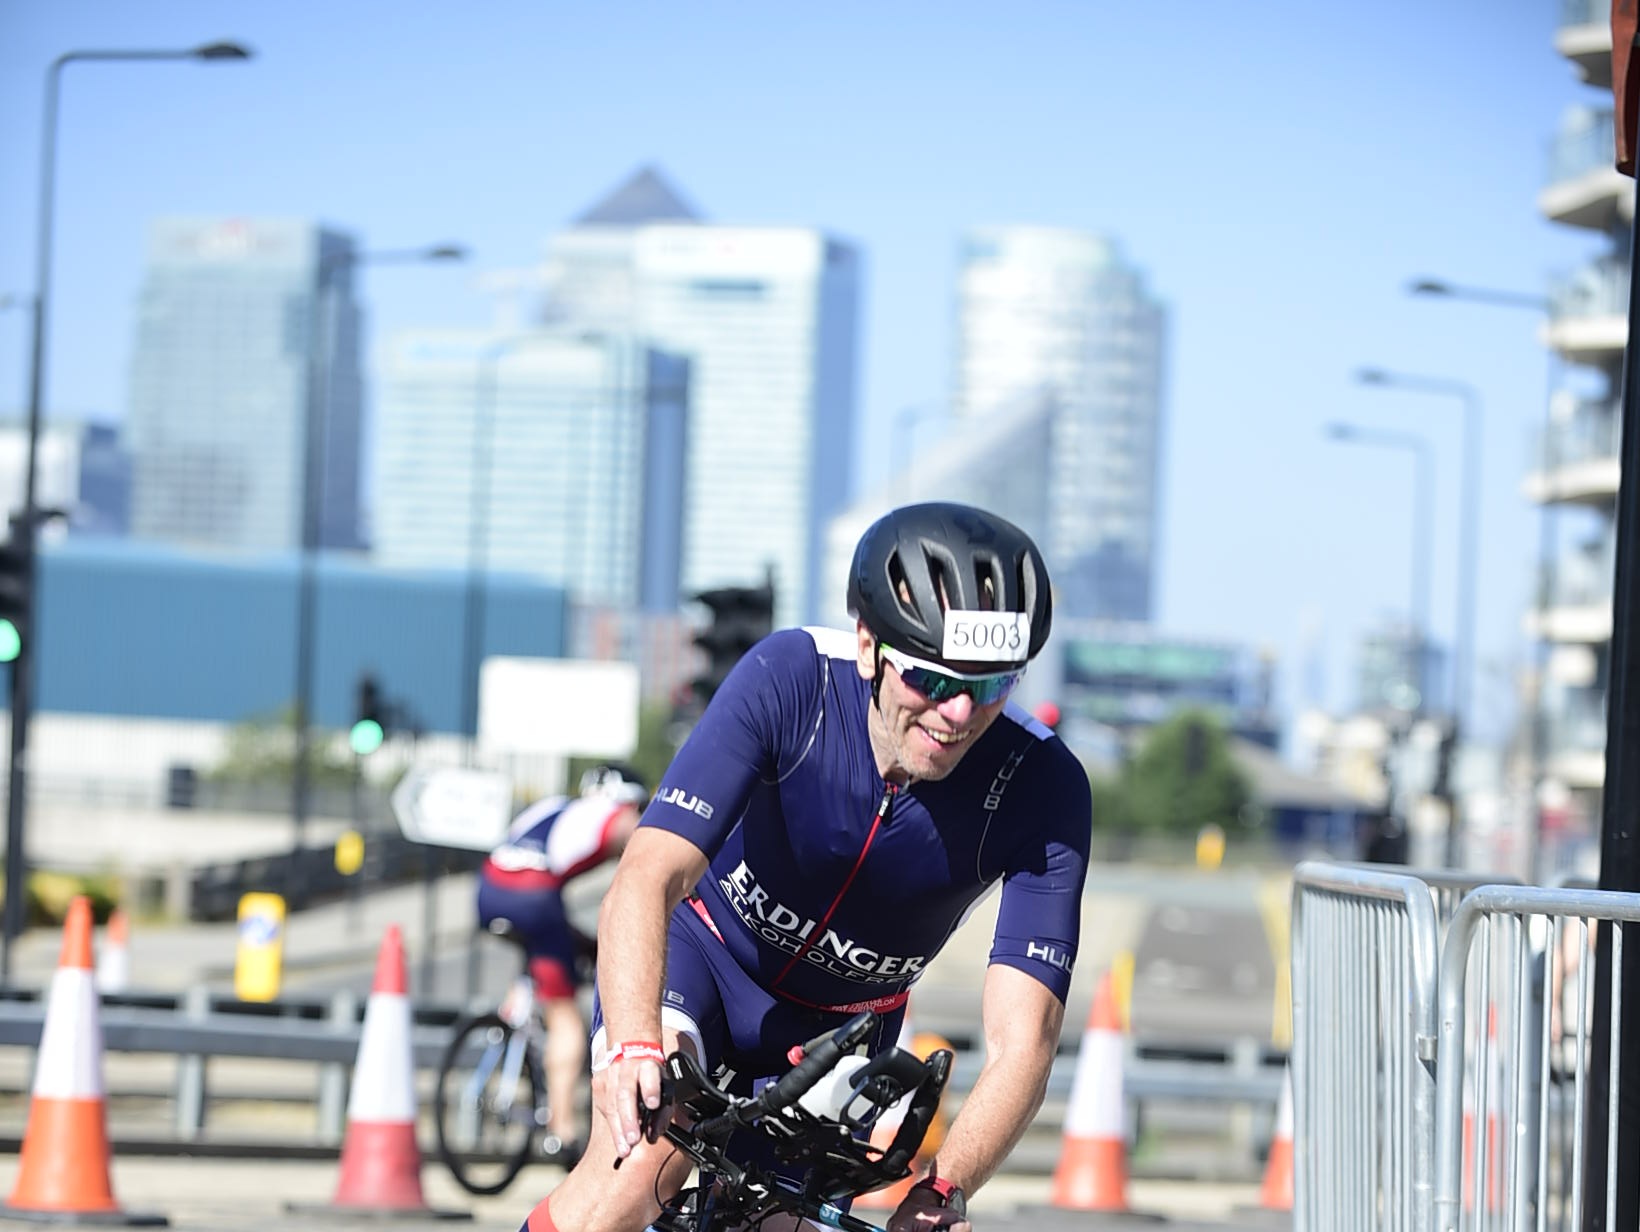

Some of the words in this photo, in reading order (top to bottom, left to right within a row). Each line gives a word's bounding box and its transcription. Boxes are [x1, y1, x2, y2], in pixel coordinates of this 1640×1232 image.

[953, 622, 1021, 650] 5003
[983, 751, 1023, 810] HUUB
[719, 878, 912, 985] ALKOHOLFRE
[728, 859, 925, 975] ERDINGER
